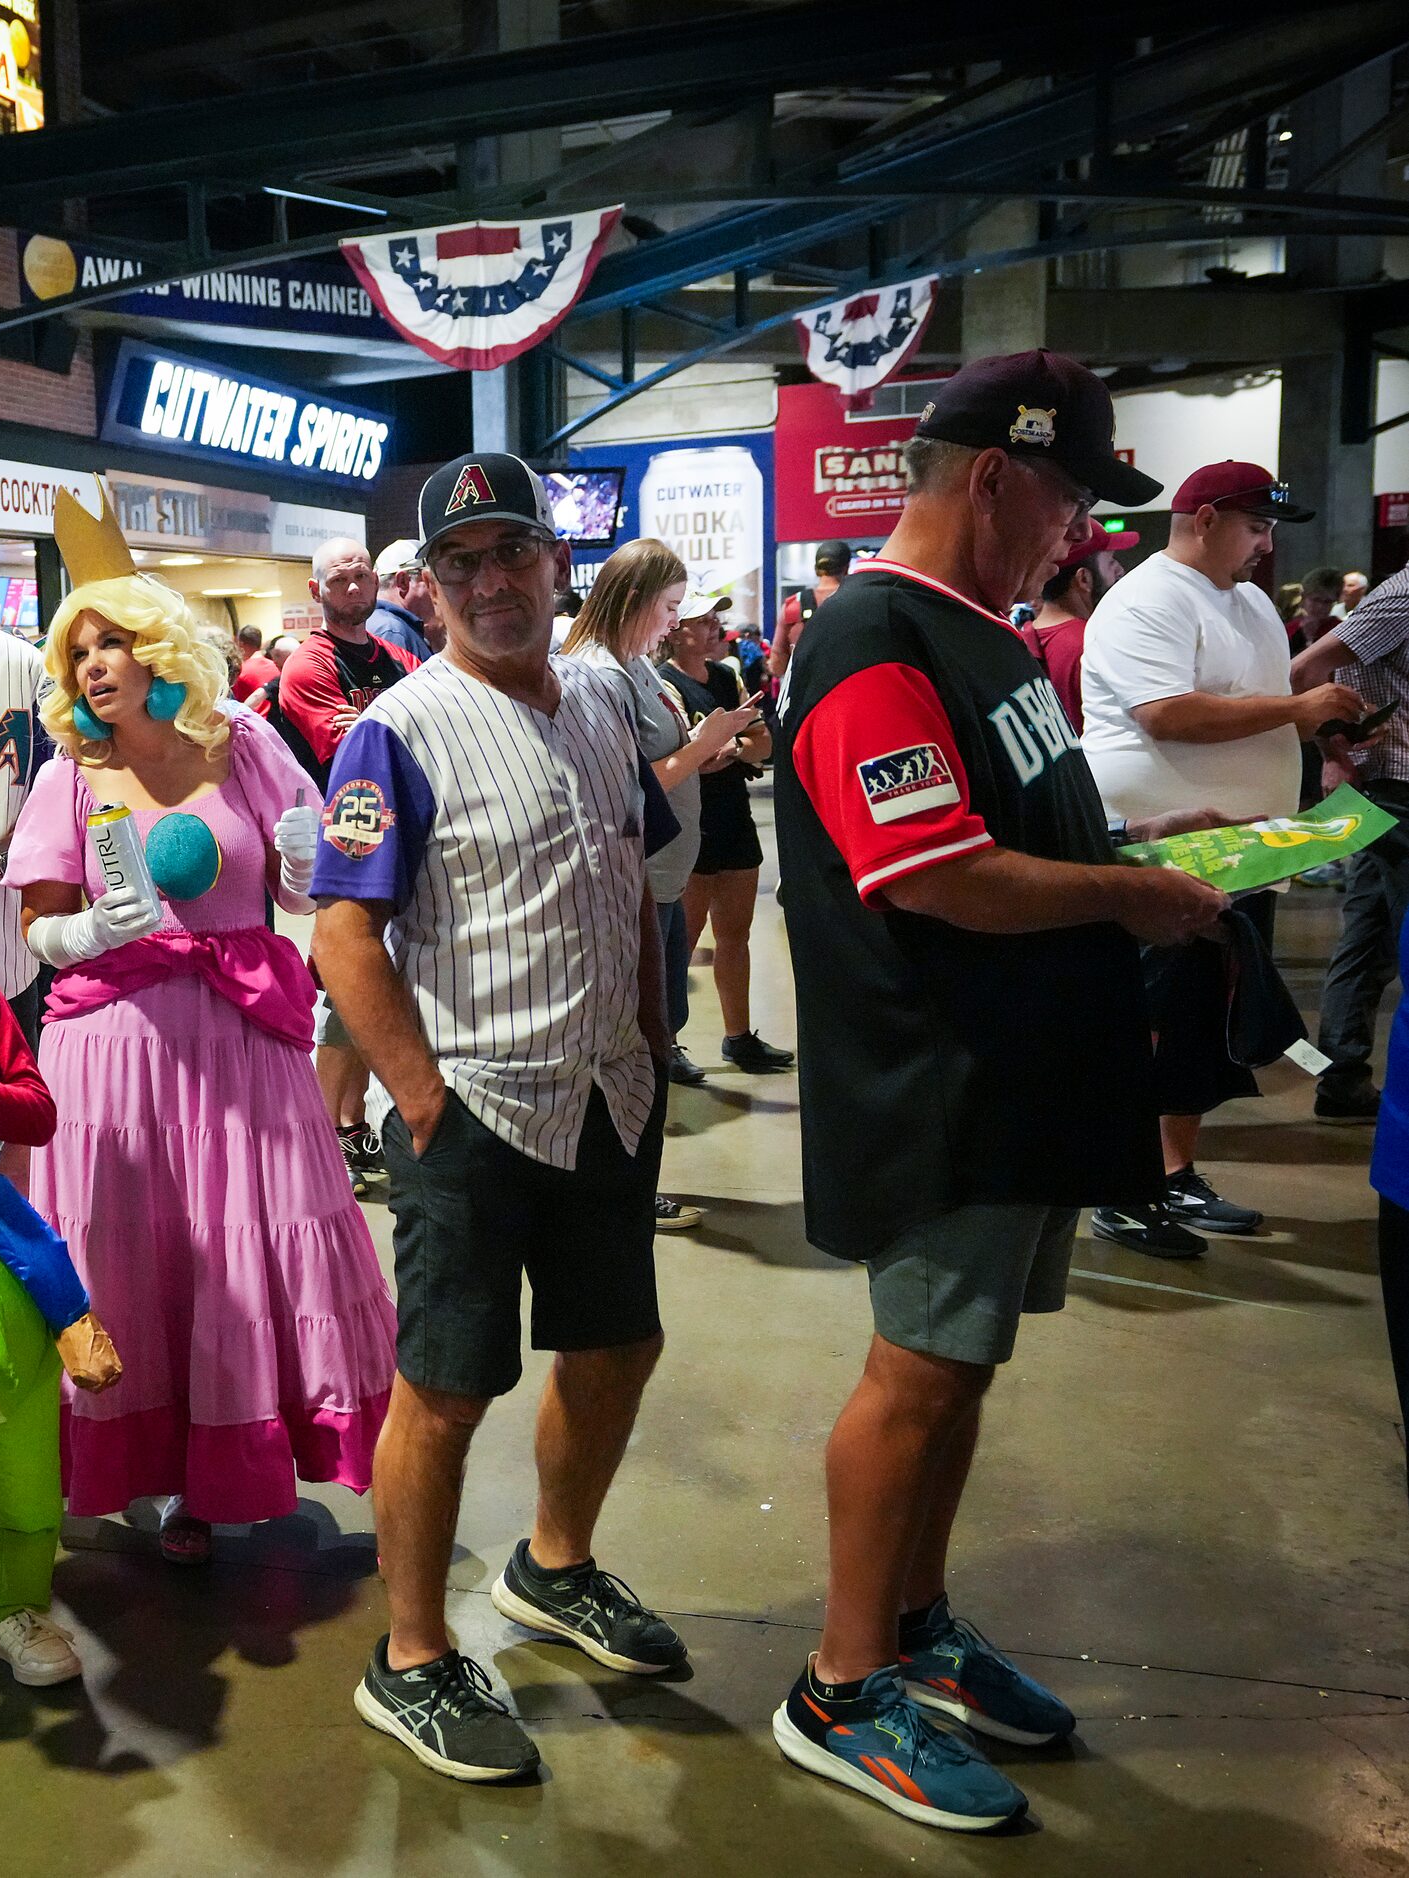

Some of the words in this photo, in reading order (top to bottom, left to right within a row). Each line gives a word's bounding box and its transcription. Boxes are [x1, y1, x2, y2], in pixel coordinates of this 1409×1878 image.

[289, 280, 372, 318] CANNED
[141, 360, 297, 462] CUTWATER
[290, 402, 389, 481] SPIRITS
[1011, 428, 1053, 438] POSTSEASON
[0, 477, 80, 516] COCKTA
[657, 482, 743, 502] CUTWATER
[655, 509, 745, 537] VODKA
[887, 783, 918, 798] THANK
[340, 795, 379, 831] 25
